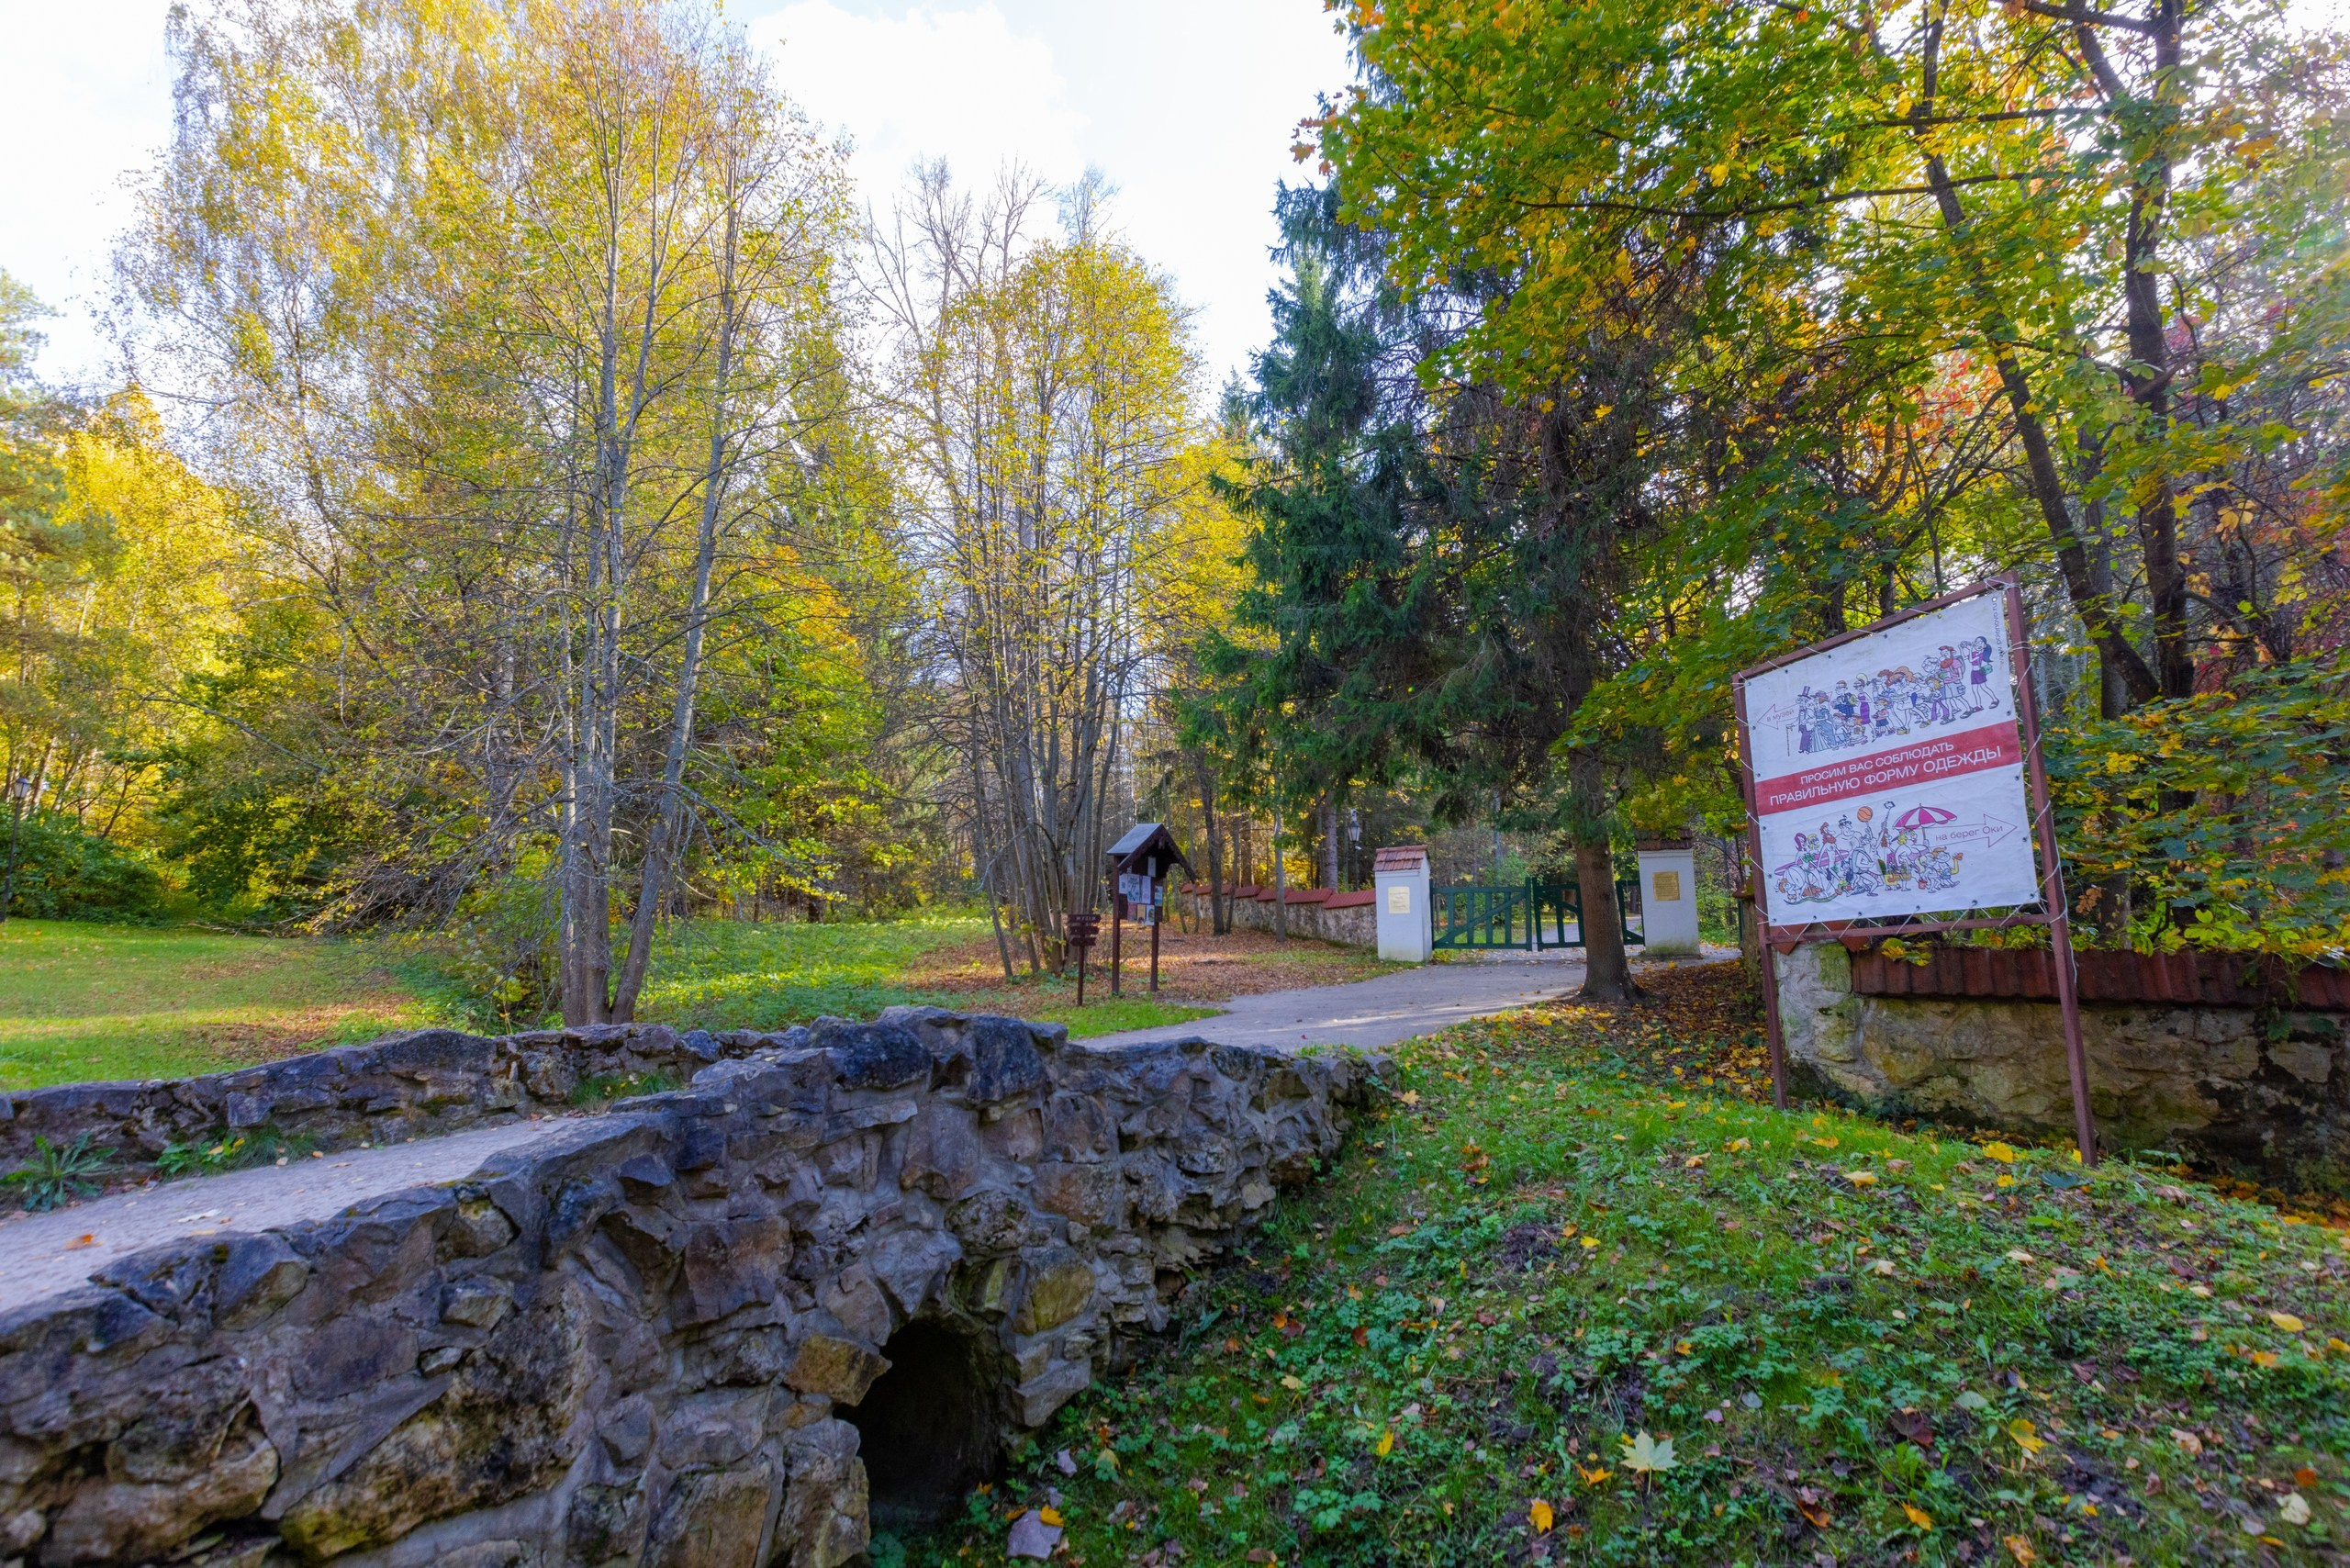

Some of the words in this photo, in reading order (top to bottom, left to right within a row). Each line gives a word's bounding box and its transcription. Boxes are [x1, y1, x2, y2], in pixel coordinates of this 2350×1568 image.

[1773, 708, 1795, 721] музей
[1770, 777, 1861, 806] ПРАВИЛЬНУЮ
[1863, 764, 1919, 785] ФОРМУ
[1923, 745, 2002, 773] ОДЕЖДЫ
[1800, 767, 1846, 785] ПРОСИМ
[1849, 760, 1874, 774] ВАС
[1875, 742, 1954, 767] СОБЛЮДАТЬ
[1950, 828, 1979, 840] берег
[1982, 824, 2004, 834] Оки
